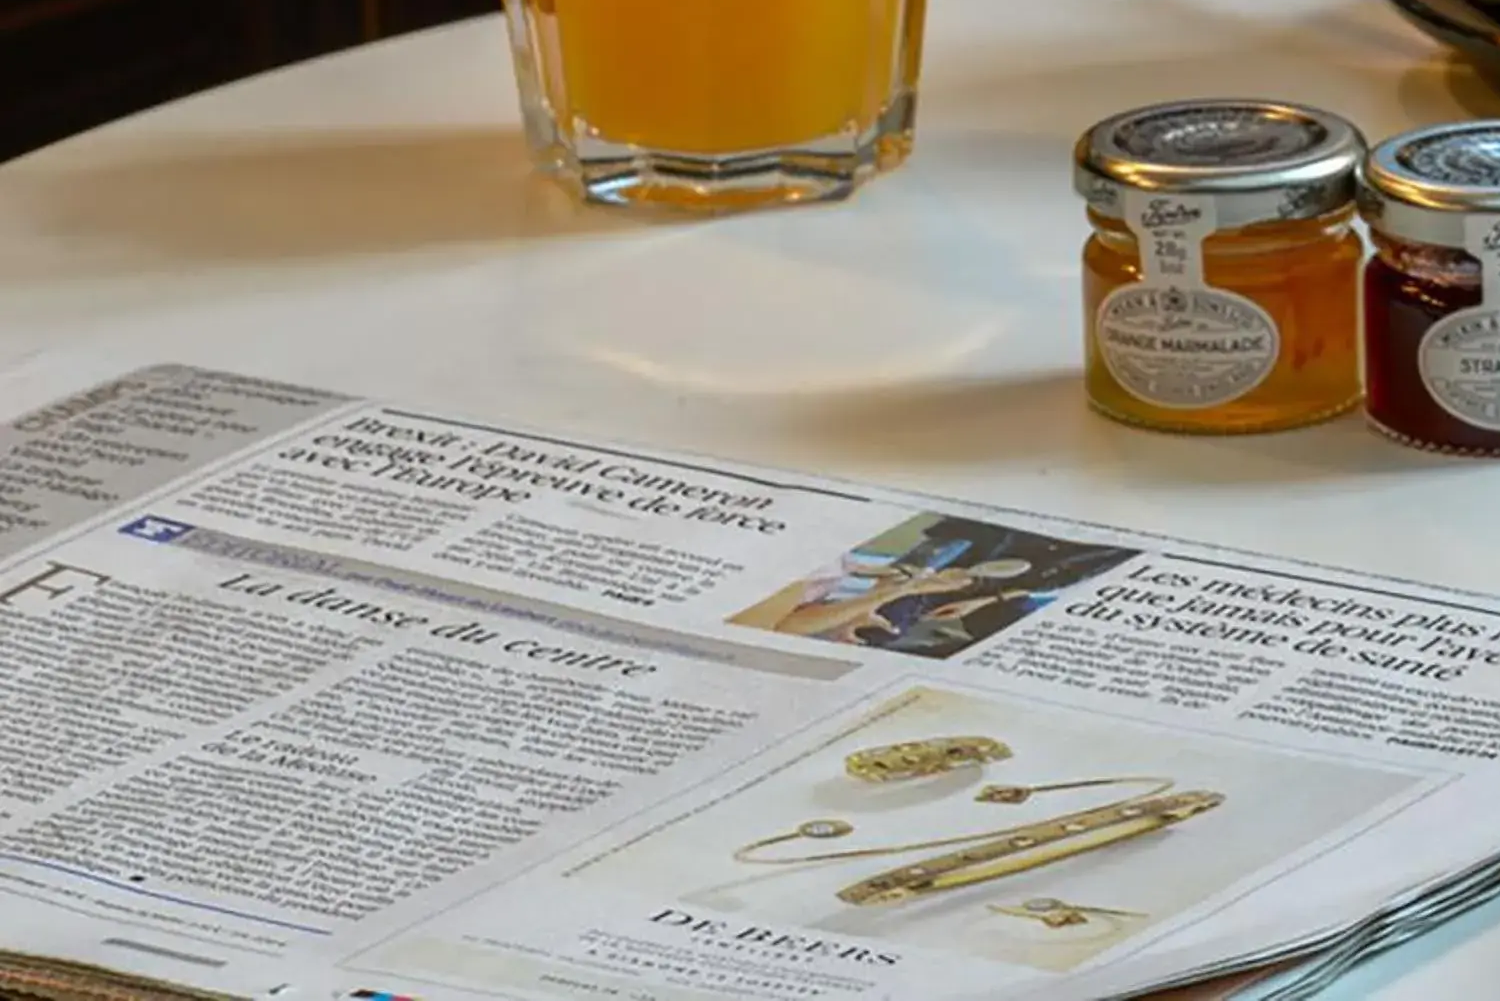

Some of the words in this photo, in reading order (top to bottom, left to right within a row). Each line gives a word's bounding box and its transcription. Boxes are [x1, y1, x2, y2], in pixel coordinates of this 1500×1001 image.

[1160, 334, 1265, 353] MARMALADE
[279, 449, 371, 471] avec
[313, 435, 446, 466] engage
[628, 495, 681, 515] de
[684, 505, 786, 535] force
[344, 417, 462, 447] Brexit
[484, 441, 602, 474] David
[599, 464, 774, 510] Cameron
[218, 573, 284, 597] La
[286, 588, 429, 628] danse
[430, 621, 499, 644] du
[504, 639, 657, 677] centre
[1096, 585, 1176, 606] que
[1165, 595, 1310, 627] jamais
[1304, 618, 1418, 650] pour
[1127, 564, 1198, 587] Les
[1201, 577, 1393, 622] médecins
[1391, 611, 1487, 639] plus
[1065, 601, 1123, 622] du
[1123, 613, 1289, 647] système
[1292, 637, 1348, 657] de
[1349, 649, 1469, 683] santé
[649, 908, 728, 935] DE
[735, 926, 904, 966] BEERS
